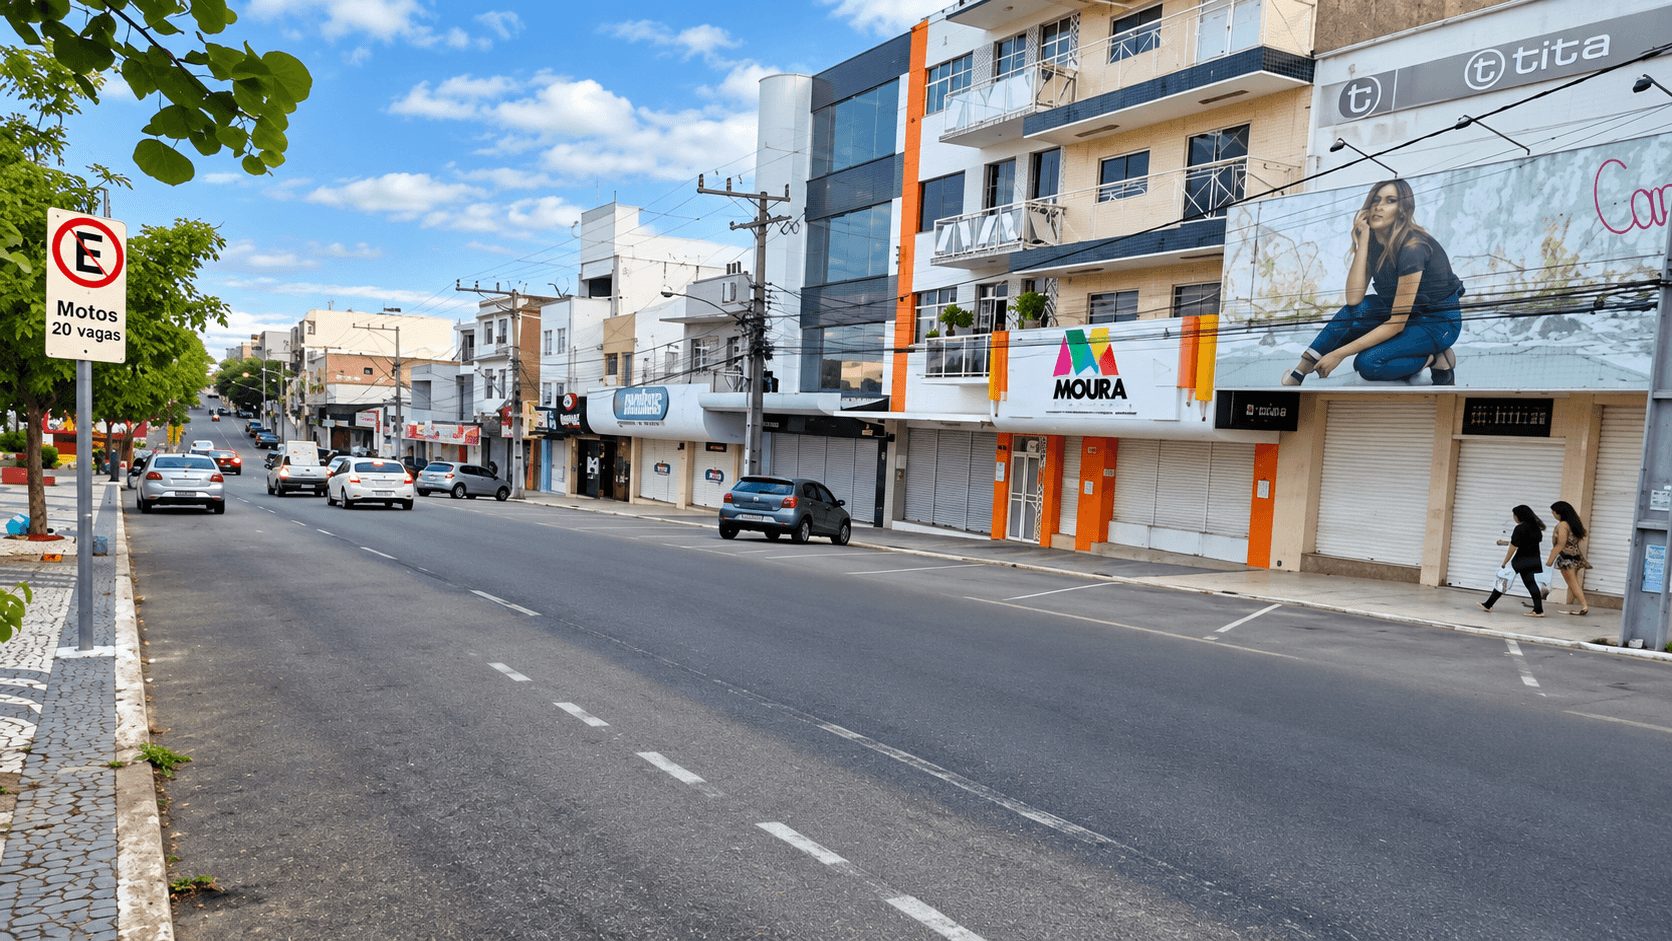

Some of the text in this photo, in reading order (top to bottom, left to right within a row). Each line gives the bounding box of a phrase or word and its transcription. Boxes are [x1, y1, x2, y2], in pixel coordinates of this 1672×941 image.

[1512, 33, 1611, 75] tita
[1347, 83, 1372, 113] t
[76, 230, 103, 275] E
[57, 300, 118, 323] Motos
[52, 321, 121, 343] 20 vagas
[1053, 378, 1128, 400] MOURA
